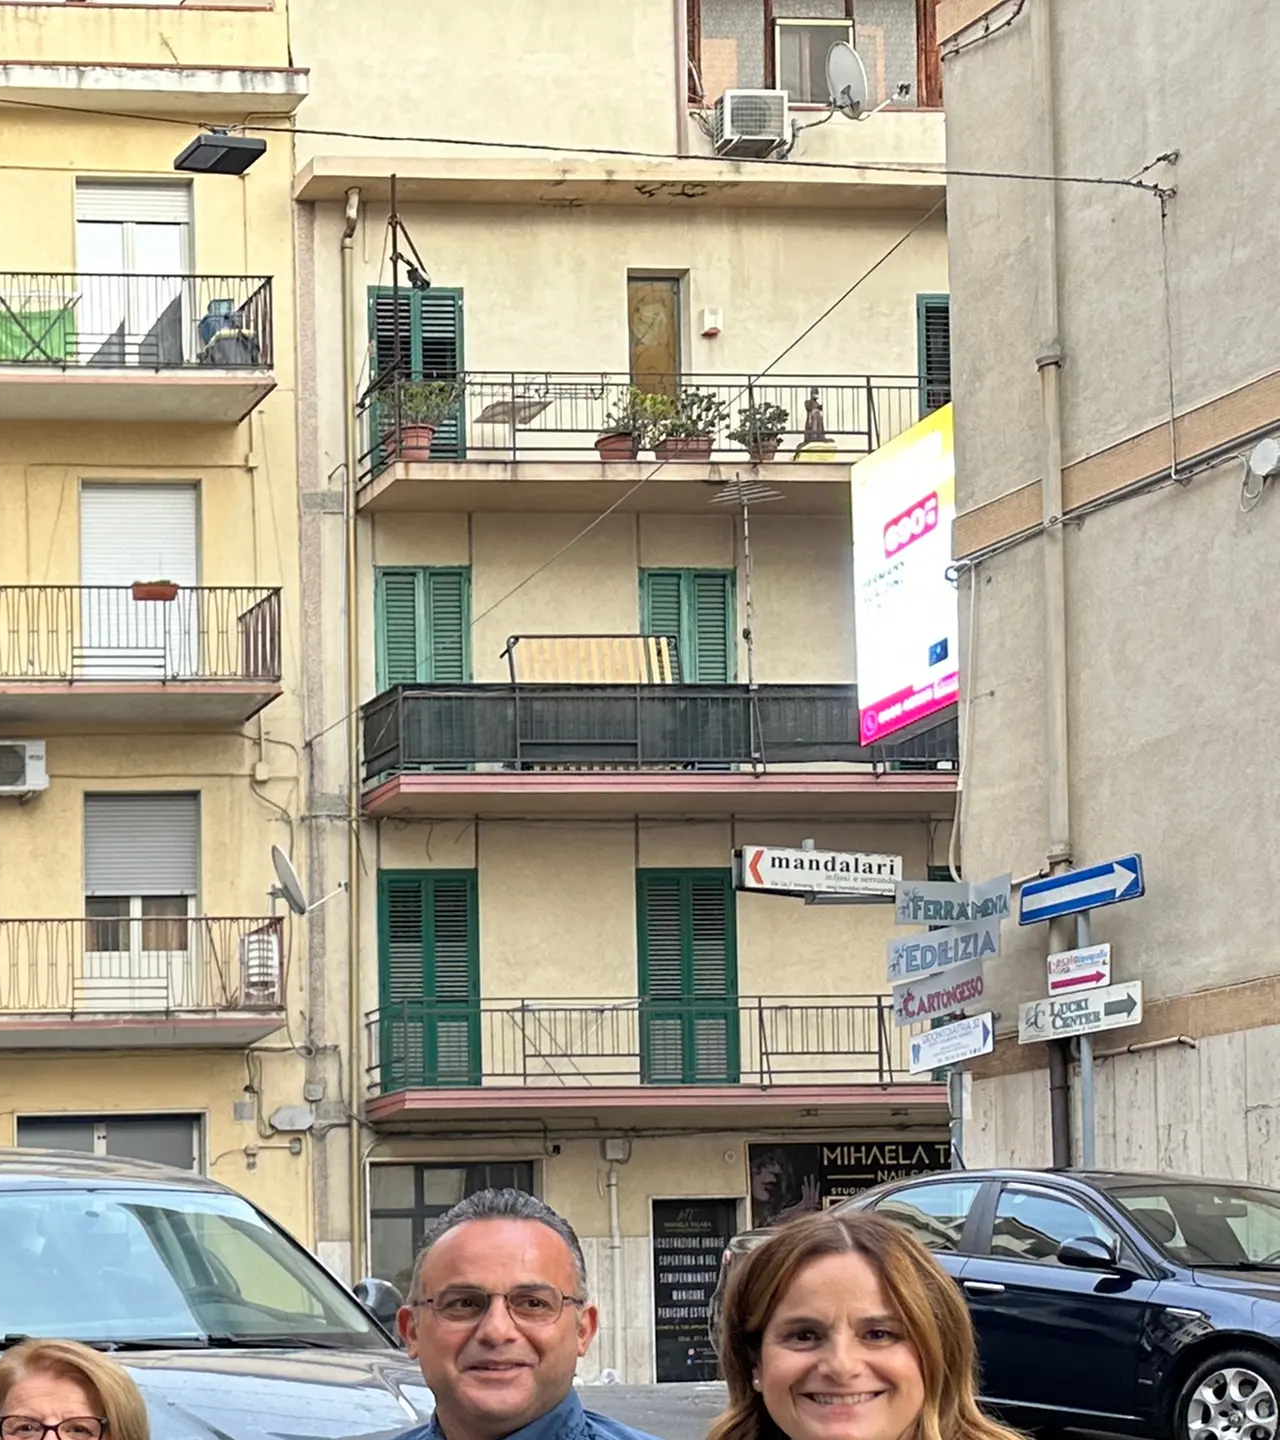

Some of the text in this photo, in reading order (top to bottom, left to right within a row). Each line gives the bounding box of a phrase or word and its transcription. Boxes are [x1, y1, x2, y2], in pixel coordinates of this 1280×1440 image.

[770, 855, 895, 876] mandalari
[910, 893, 1009, 920] FERRAMENTA
[905, 930, 995, 973] EDILIZIA
[903, 975, 984, 1018] CARTONGESSO
[1048, 998, 1089, 1017] LUCKI
[1052, 1011, 1101, 1030] CENTER
[823, 1145, 929, 1166] MIHAELA
[672, 1289, 705, 1300] MANICURE
[657, 1307, 688, 1318] PEDICURE
